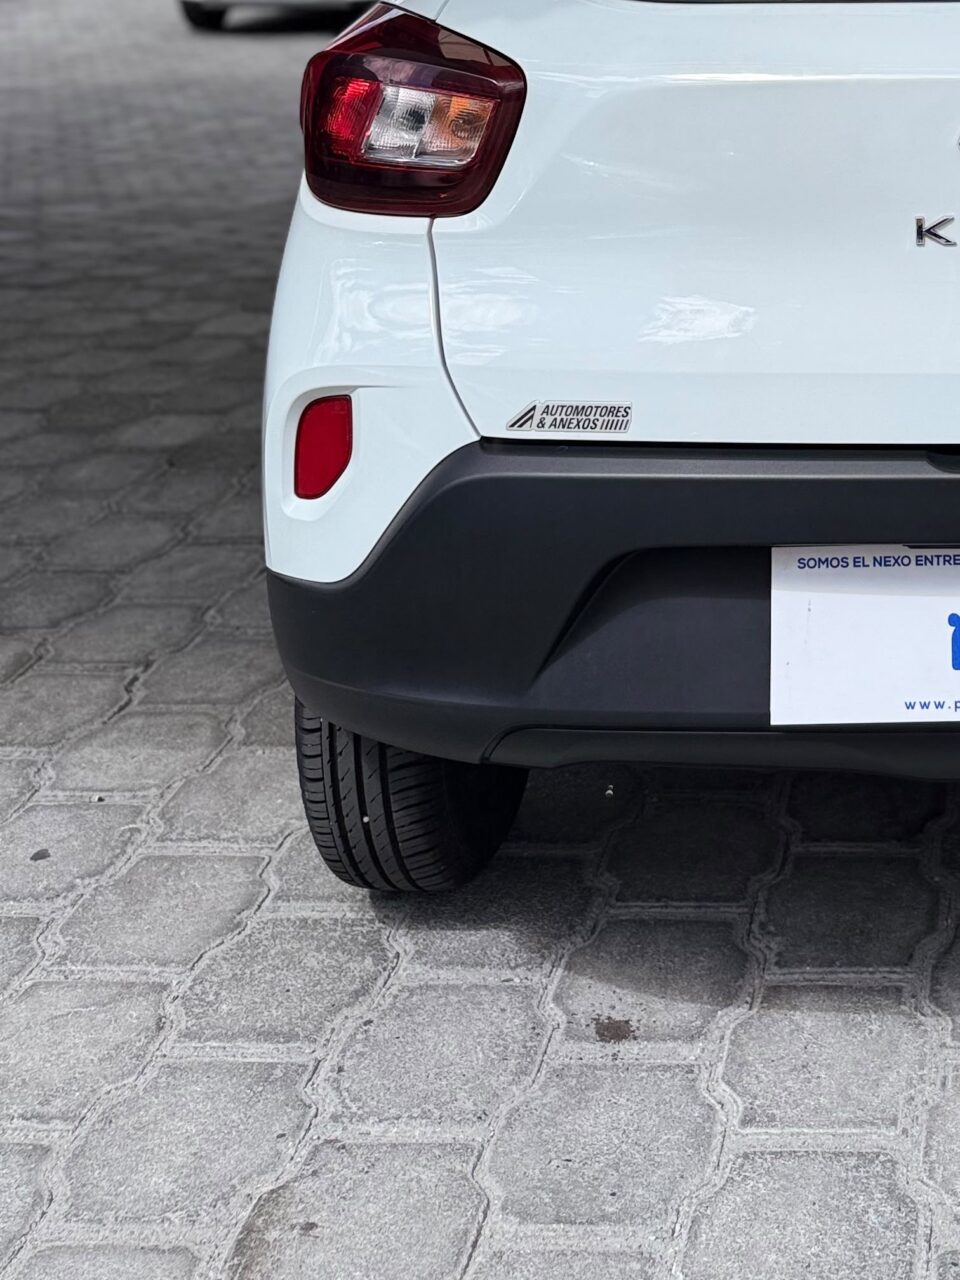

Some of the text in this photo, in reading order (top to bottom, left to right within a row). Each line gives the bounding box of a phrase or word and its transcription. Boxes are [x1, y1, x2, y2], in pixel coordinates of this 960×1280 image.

[540, 404, 631, 418] AUTOMOTORES
[536, 416, 600, 430] & ANEXOS
[797, 556, 850, 570] SOMOS
[852, 555, 870, 568] EL
[872, 554, 912, 568] NEXO
[915, 553, 960, 567] ENTRE
